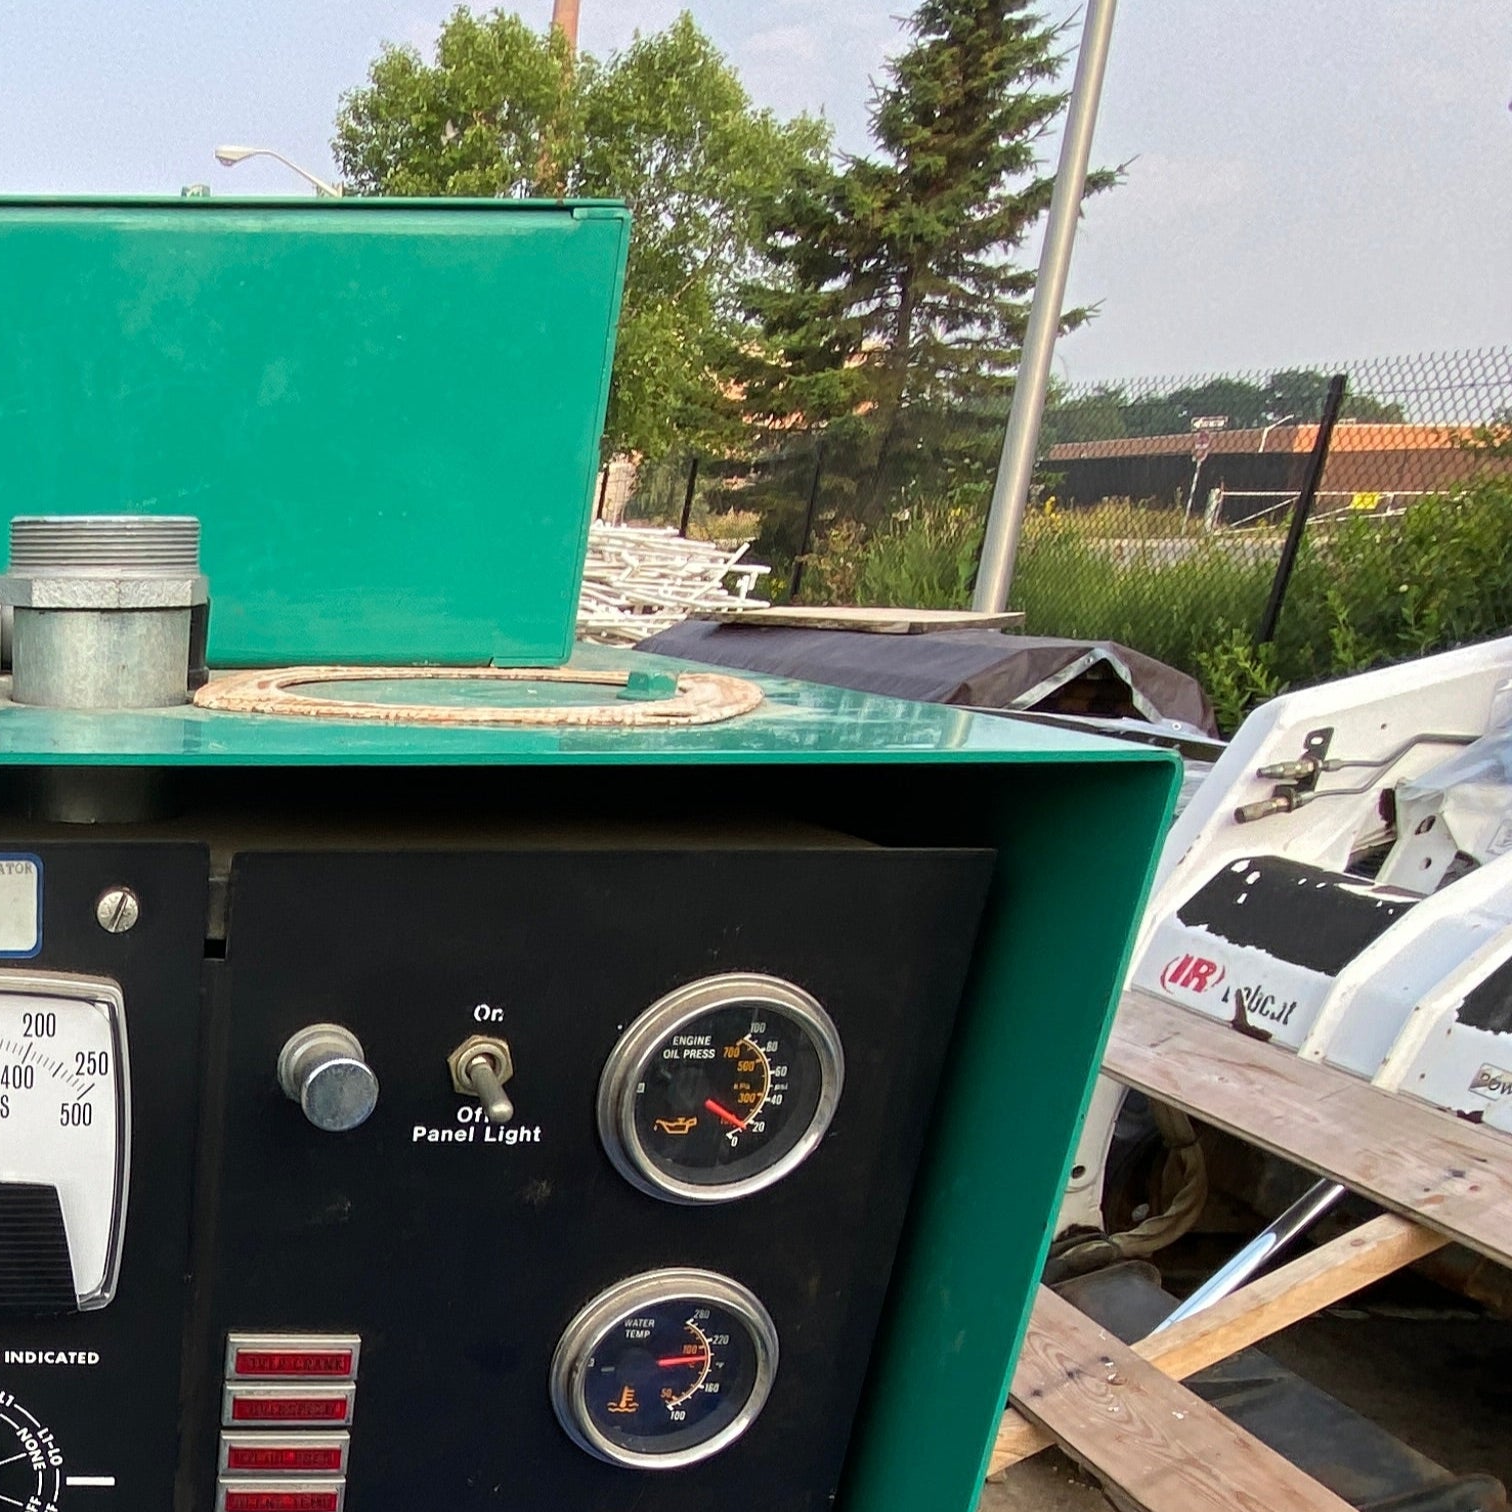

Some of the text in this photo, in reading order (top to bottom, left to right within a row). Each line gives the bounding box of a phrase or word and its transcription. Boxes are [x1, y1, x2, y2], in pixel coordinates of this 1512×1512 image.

[22, 1012, 56, 1037] 200
[672, 1036, 711, 1046] ENGINE
[663, 1049, 716, 1060] OIL PRESS
[75, 1051, 109, 1076] 250
[0, 1065, 34, 1089] 400
[775, 1066, 788, 1077] 60
[770, 1094, 783, 1105] 40
[60, 1102, 92, 1127] 500
[752, 1121, 765, 1133] 20
[412, 1126, 542, 1145] Panel Light
[730, 1136, 738, 1147] 0
[624, 1318, 655, 1328] WATER
[625, 1329, 651, 1339] TEMP
[712, 1335, 729, 1345] 220
[4, 1351, 100, 1365] INDICATED
[16, 1427, 47, 1471] NONE
